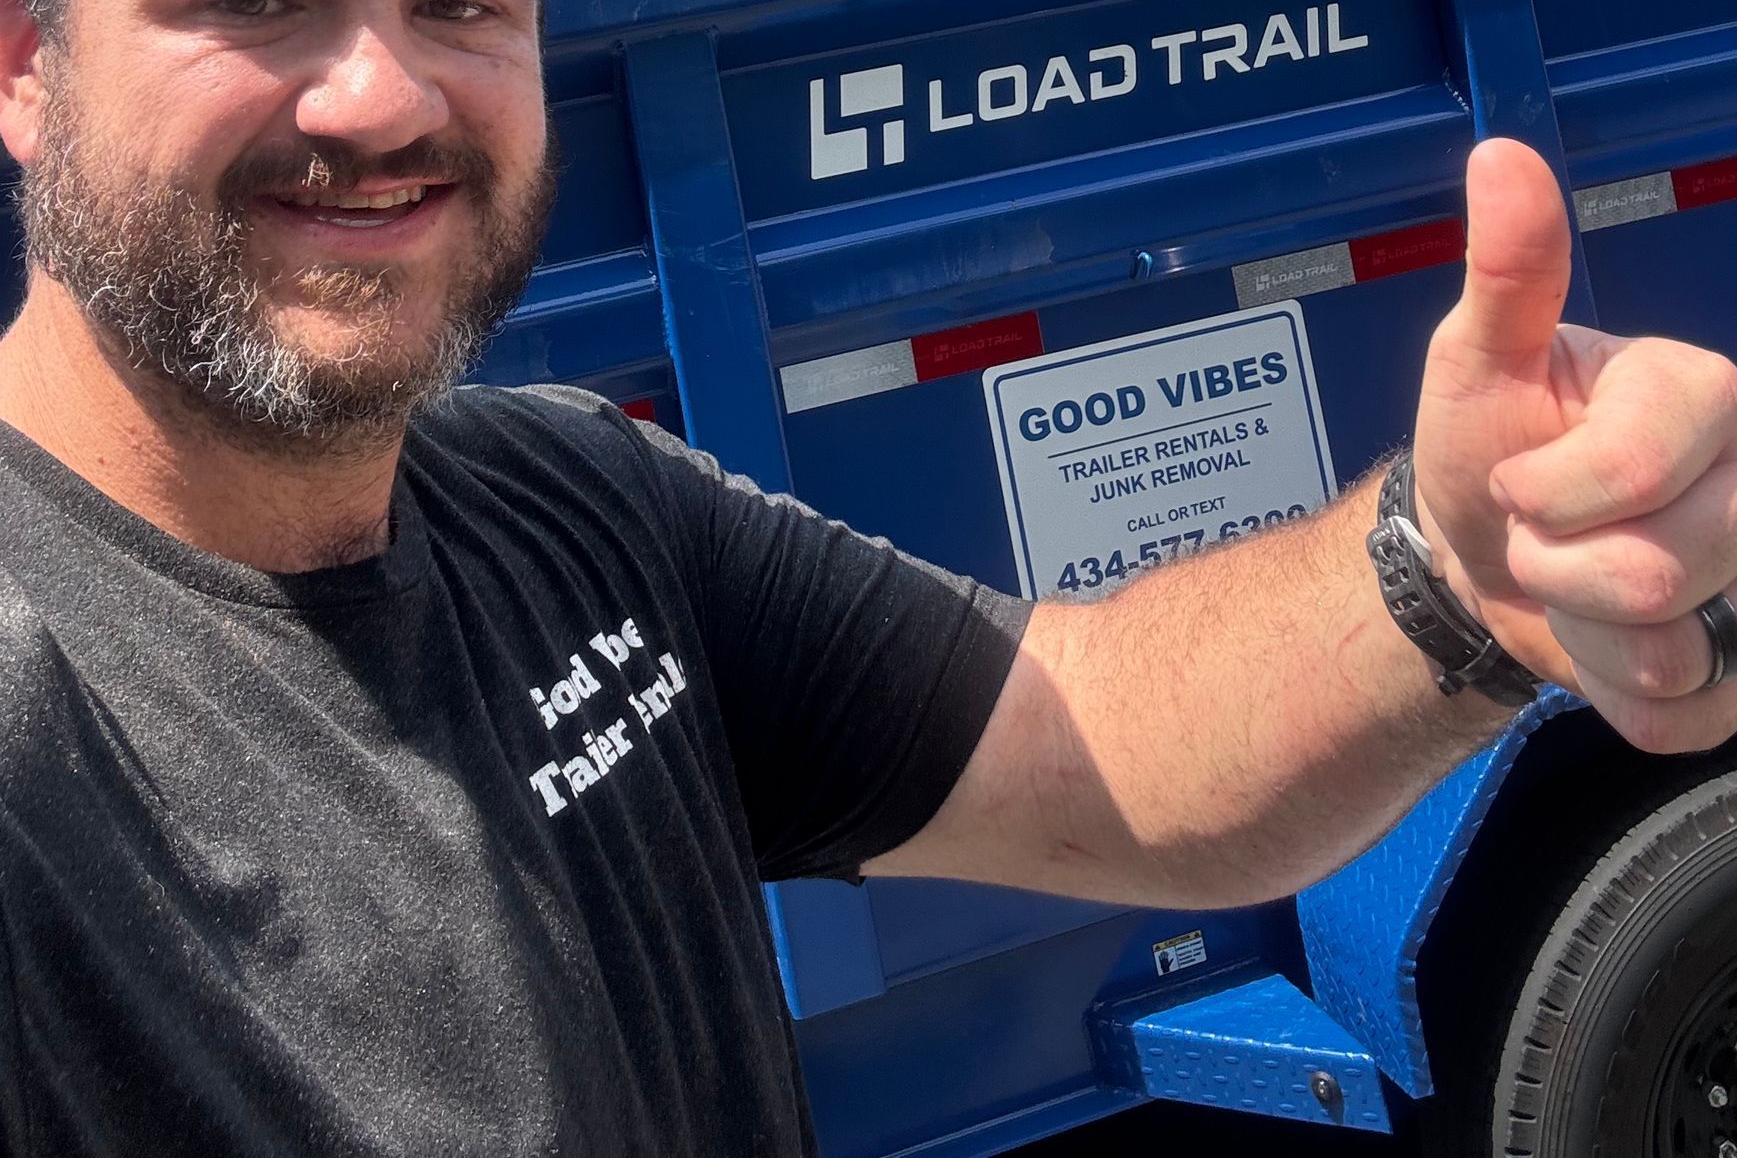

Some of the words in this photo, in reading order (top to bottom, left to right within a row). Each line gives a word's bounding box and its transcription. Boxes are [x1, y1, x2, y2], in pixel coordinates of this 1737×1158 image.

[928, 43, 1137, 132] LOAD
[1151, 3, 1368, 85] TRAIL
[1272, 271, 1303, 286] LOAD
[1304, 263, 1339, 277] TRAIL
[1018, 385, 1147, 443] GOOD
[1156, 351, 1289, 409] VIBES
[1058, 445, 1151, 484] TRAILER
[1154, 422, 1249, 460] RENTALS
[1254, 417, 1270, 436] &
[1089, 473, 1147, 504] JUNK
[1150, 449, 1251, 488] REMOVAL
[1127, 513, 1166, 532] CALL
[1168, 505, 1190, 522] OR
[1191, 496, 1227, 517] TEXT
